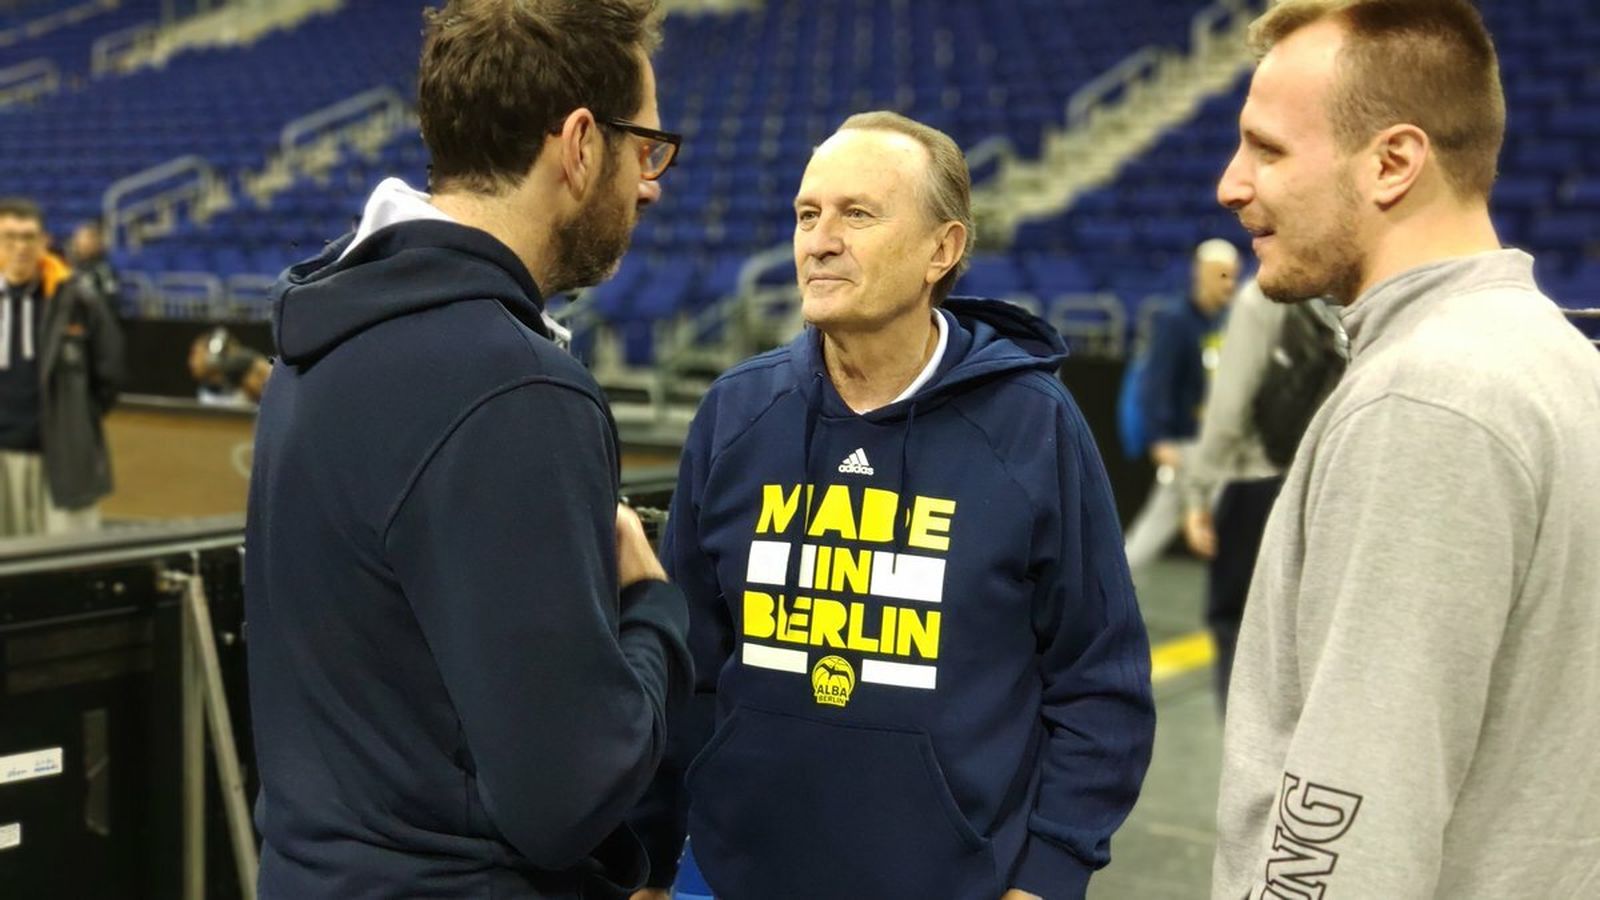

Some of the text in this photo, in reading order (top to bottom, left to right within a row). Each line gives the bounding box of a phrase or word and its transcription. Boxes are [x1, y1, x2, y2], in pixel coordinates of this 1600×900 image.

[838, 463, 874, 476] adidas
[756, 484, 956, 551] MADE
[814, 546, 872, 594] IN
[743, 590, 941, 659] BERLIN
[816, 684, 848, 698] ALBA
[818, 694, 845, 704] BERLIN
[1259, 771, 1364, 900] NG
